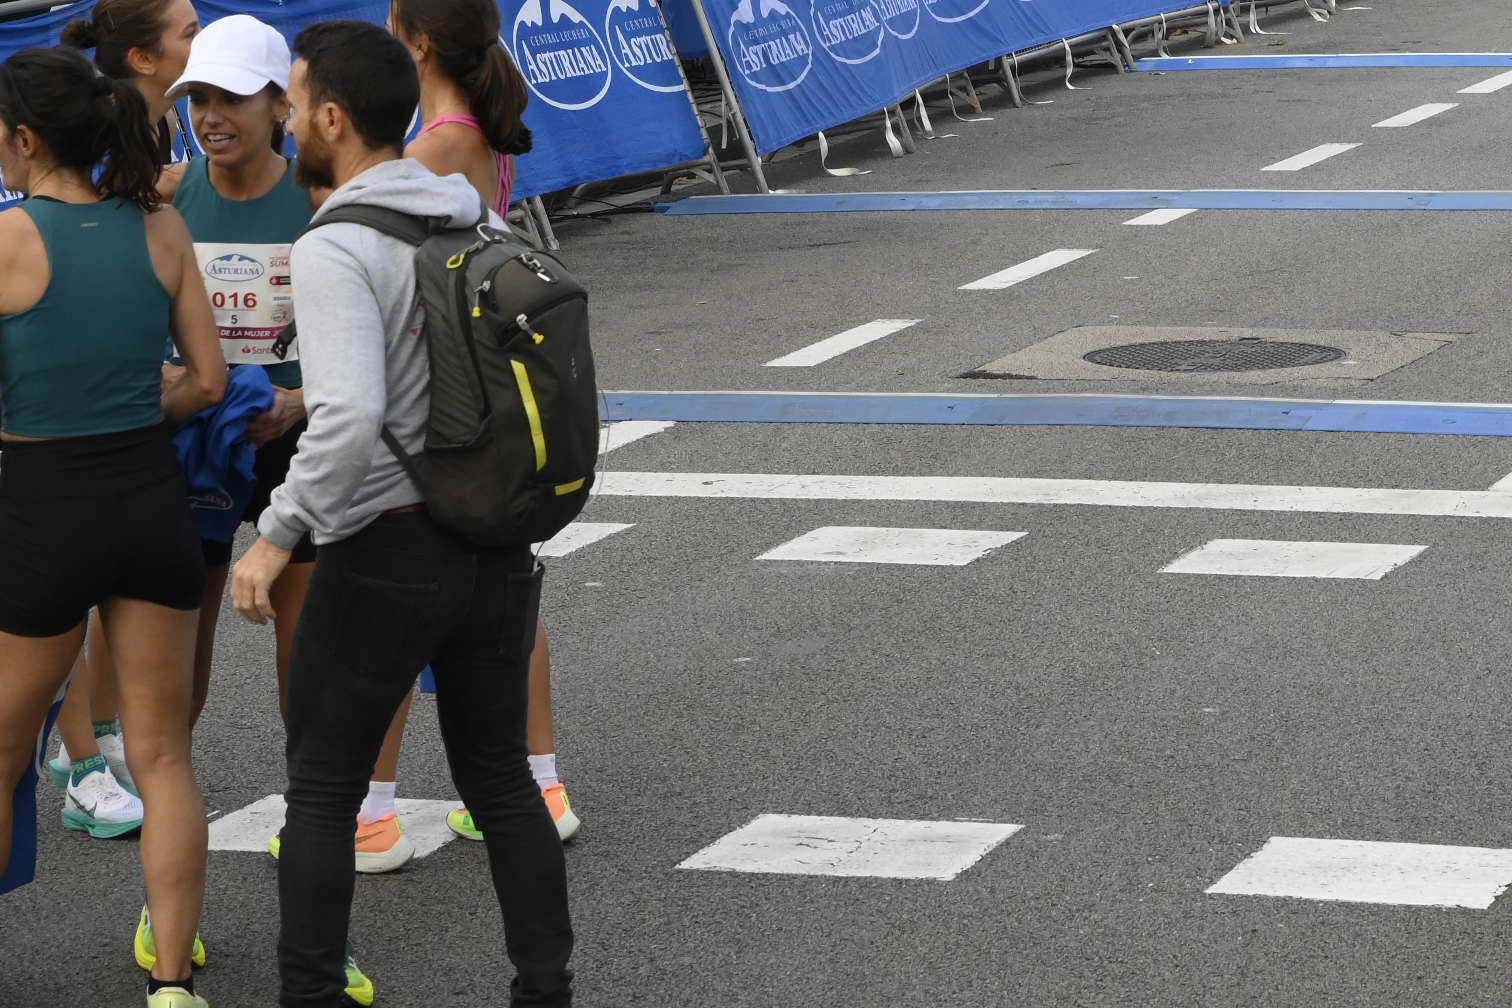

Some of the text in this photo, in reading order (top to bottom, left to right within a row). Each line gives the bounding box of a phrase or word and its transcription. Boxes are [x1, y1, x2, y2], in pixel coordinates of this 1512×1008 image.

[624, 16, 656, 31] CENTRAL
[530, 28, 590, 47] CENTRAL LECHERA
[522, 40, 607, 85] ASTURIANA
[211, 263, 259, 275] ASTURIANA
[231, 315, 238, 324] 5
